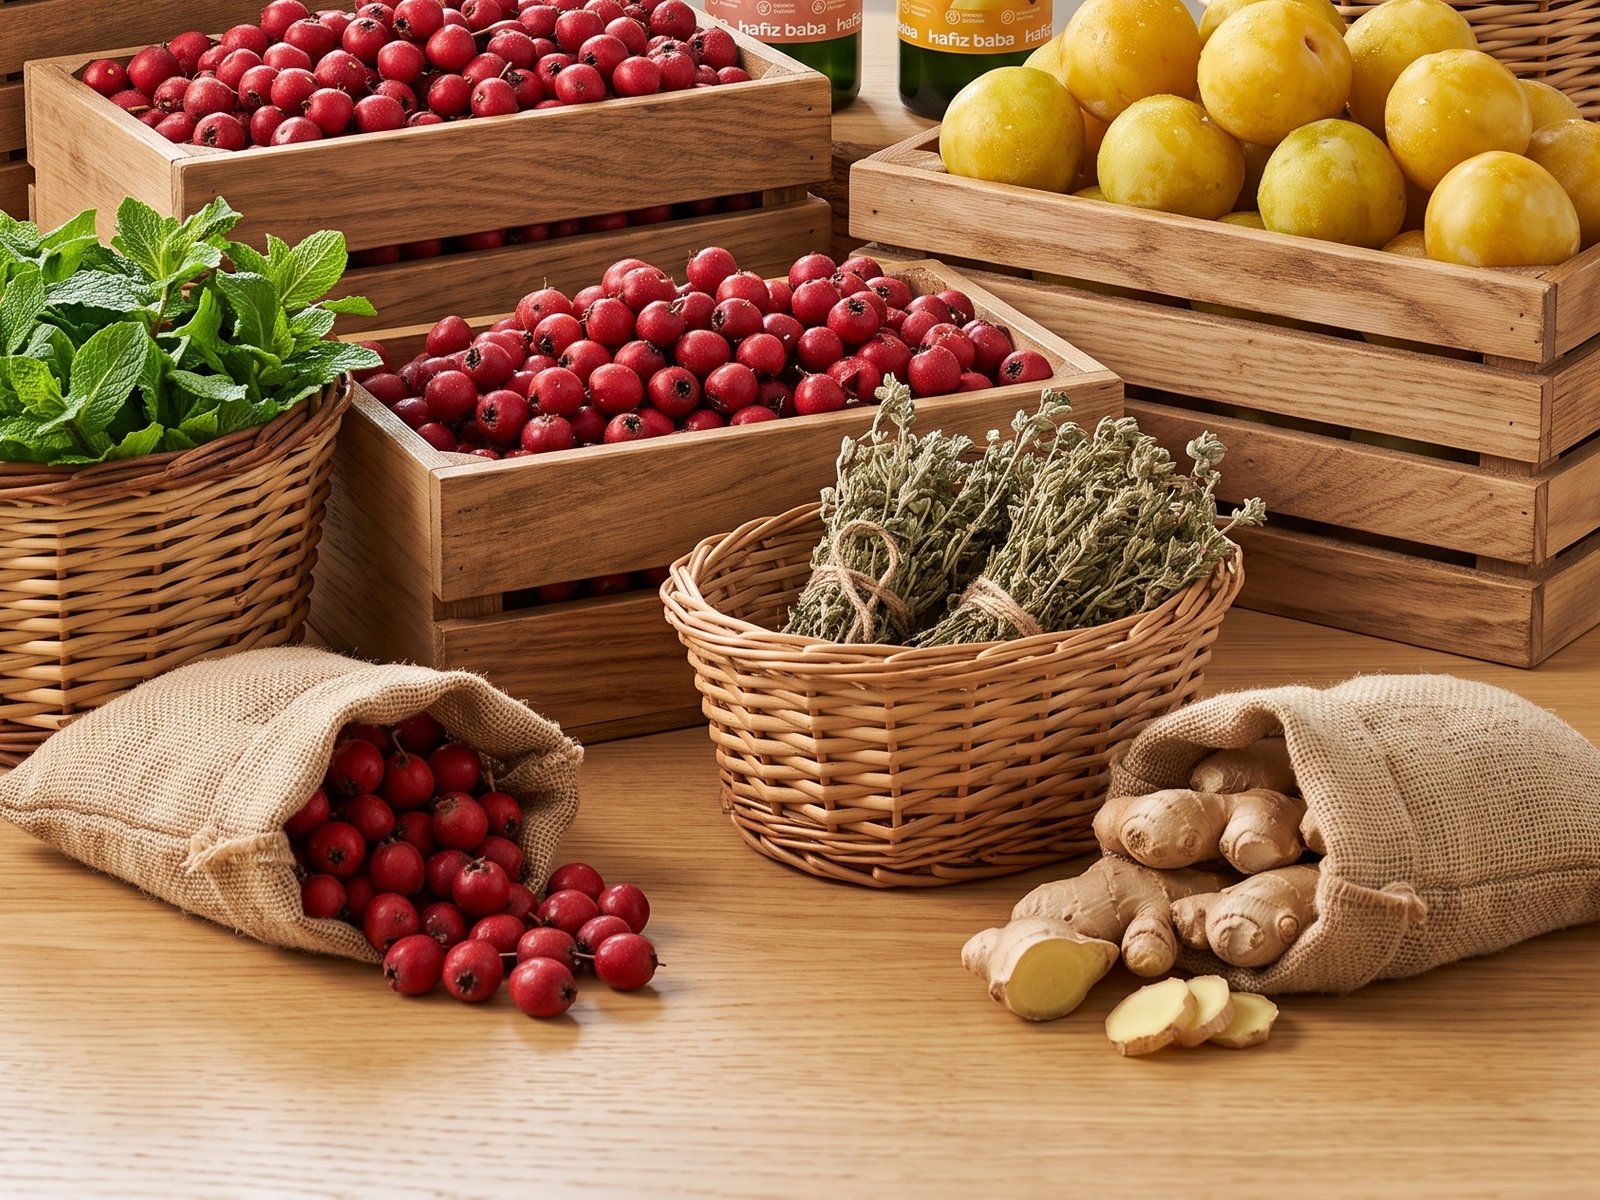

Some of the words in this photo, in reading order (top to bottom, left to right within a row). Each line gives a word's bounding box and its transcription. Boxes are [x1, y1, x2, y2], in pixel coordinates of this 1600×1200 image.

[785, 23, 827, 37] baba
[928, 28, 970, 48] hafiz
[973, 33, 1015, 48] baba
